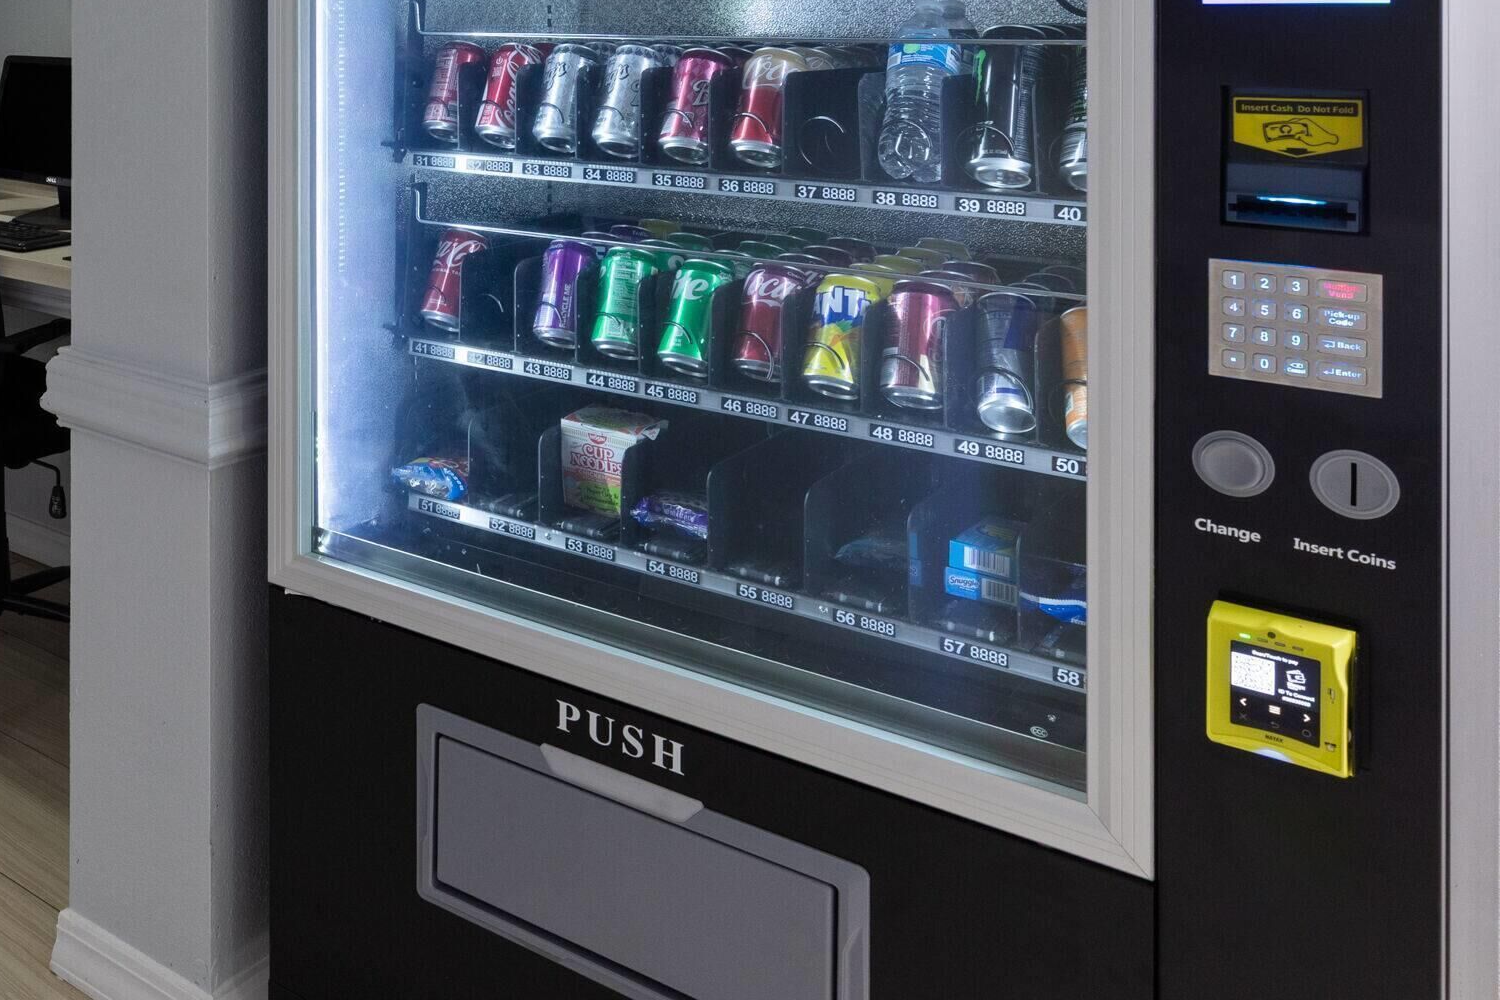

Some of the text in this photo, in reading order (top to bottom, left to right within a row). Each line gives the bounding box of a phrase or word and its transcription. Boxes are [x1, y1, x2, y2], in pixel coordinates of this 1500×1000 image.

[1241, 103, 1354, 114] Insert Cash Do Not Fold
[415, 156, 428, 165] 31
[486, 161, 511, 172] 8888
[525, 164, 569, 177] 33 8888
[585, 169, 634, 182] 34 8888
[655, 175, 704, 189] 35 8888
[721, 180, 774, 194] 36 8888
[797, 186, 855, 201] 37 8888
[876, 192, 937, 208] 38 8888
[959, 199, 1025, 215] 39 8888
[1057, 207, 1081, 221] 40
[1230, 275, 1237, 285] 1
[1260, 278, 1269, 289] 2
[1291, 281, 1300, 292] 3
[1229, 302, 1238, 312] 4
[1260, 305, 1269, 316] 5
[1292, 308, 1301, 319] 6
[1324, 309, 1361, 320] Pick-up
[1328, 317, 1354, 327] Code
[1229, 327, 1238, 338] 7
[1260, 331, 1269, 342] 8
[1291, 335, 1300, 346] 9
[1337, 341, 1362, 351] Back
[415, 343, 453, 358] 41 8888
[486, 356, 511, 369] 8888
[1260, 358, 1269, 369] 0
[526, 364, 570, 379] 43 8888
[1336, 369, 1362, 379] Enter
[589, 375, 636, 392] 44 8888
[647, 386, 697, 403] 45 8888
[723, 399, 777, 418] 46 8888
[790, 411, 847, 431] 47 8888
[872, 426, 933, 447] 48 8888
[583, 443, 614, 460] CUP
[957, 440, 1024, 463] 49 8888
[1056, 458, 1080, 475] 50
[421, 500, 434, 512] 51
[492, 519, 534, 539] 52 8888
[1194, 517, 1261, 543] Change
[567, 538, 614, 561] 53 8888
[1293, 537, 1397, 571] Insert Coins
[649, 560, 698, 583] 54 8888
[739, 585, 793, 609] 55 8888
[836, 610, 895, 636] 56 8888
[944, 638, 1008, 667] 57 8888
[1056, 668, 1080, 686] 58
[555, 699, 686, 777] PUSH
